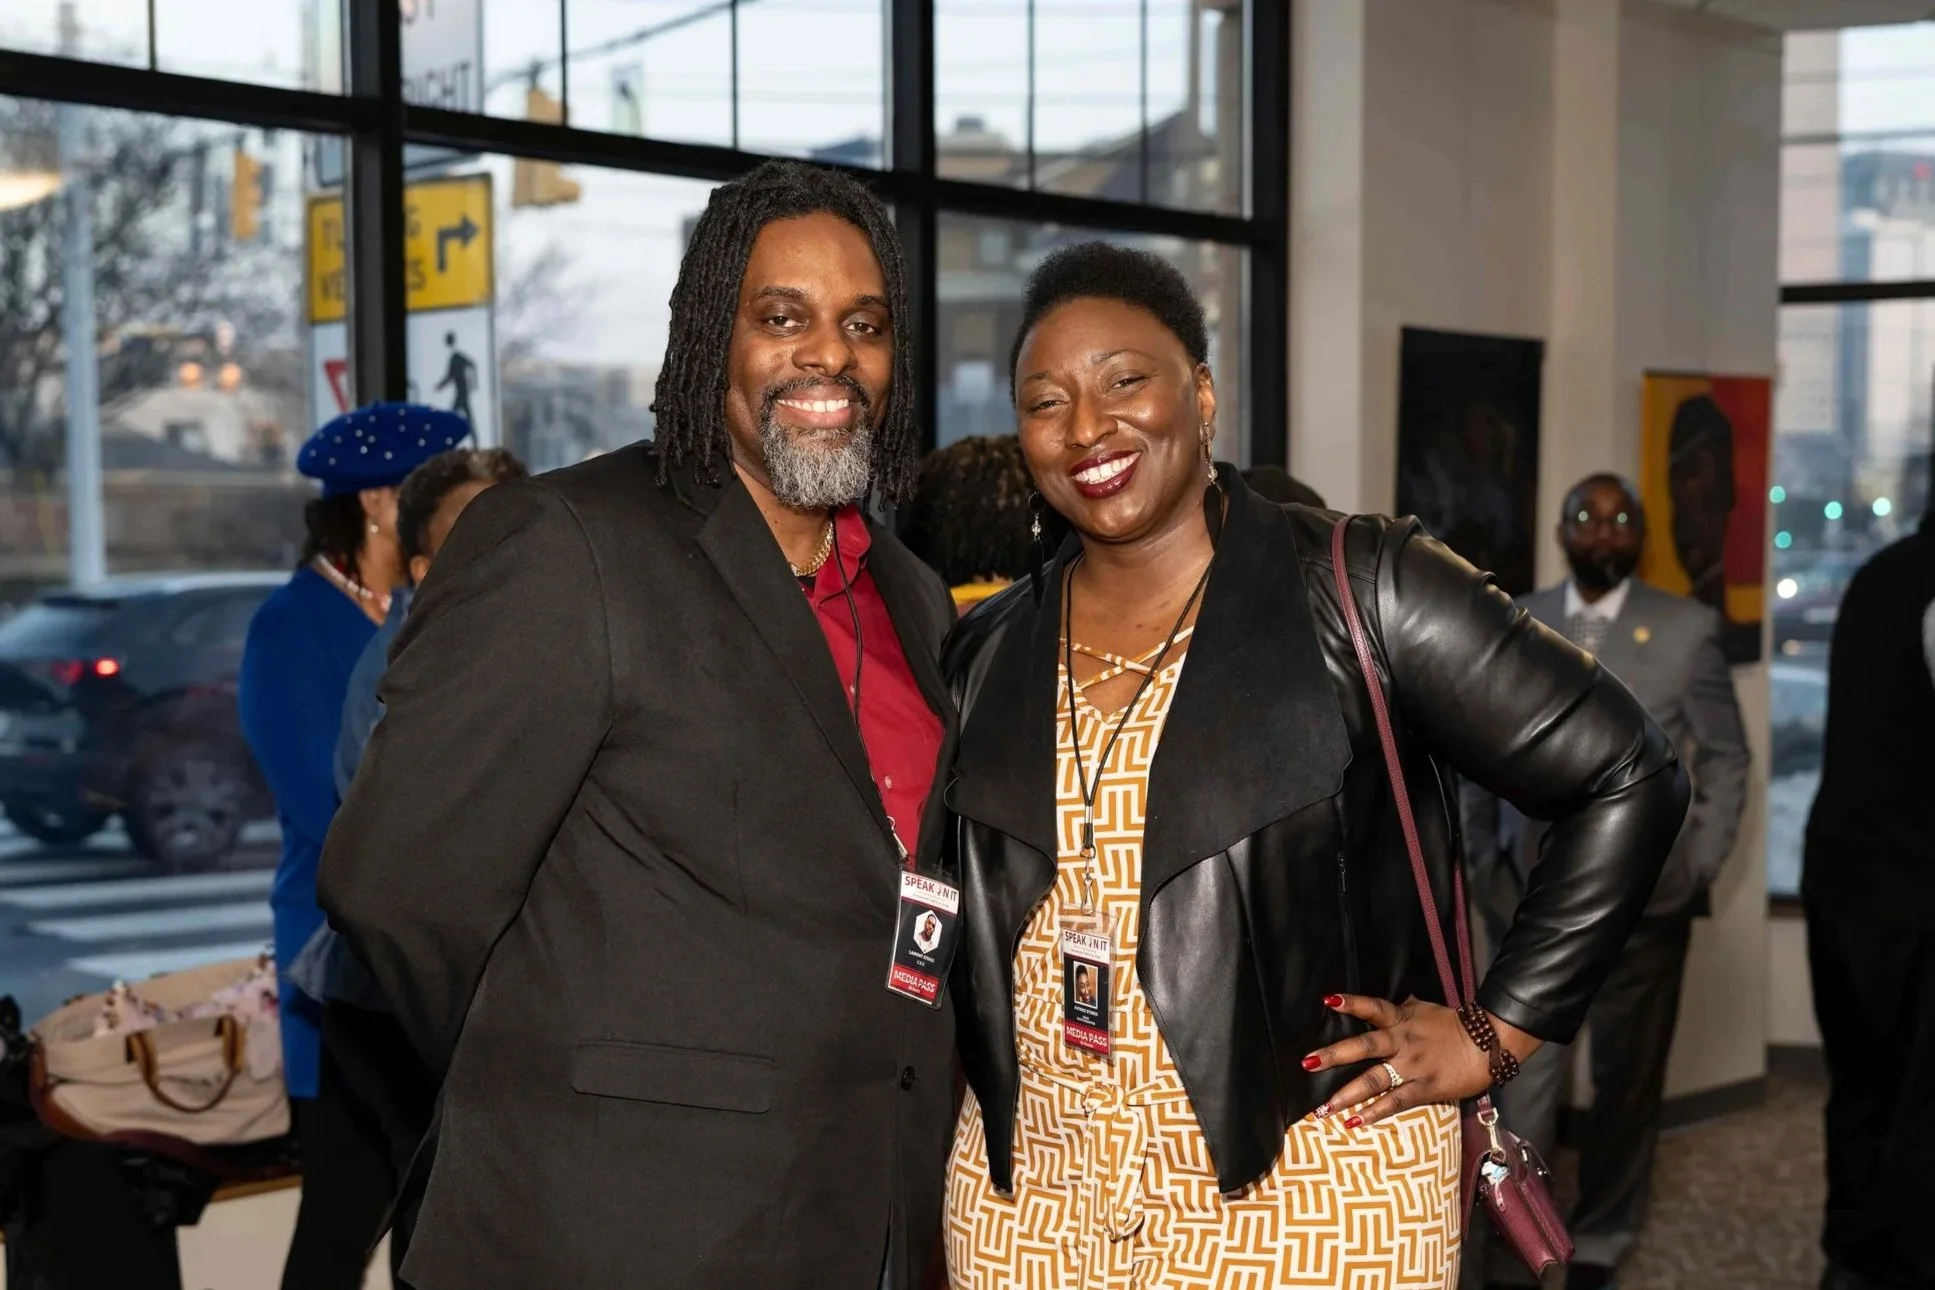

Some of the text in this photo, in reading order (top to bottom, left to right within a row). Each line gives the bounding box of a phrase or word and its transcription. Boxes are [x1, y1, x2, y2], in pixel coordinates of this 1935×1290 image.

[905, 876, 934, 893] SPEAK
[950, 890, 958, 902] IT
[1065, 931, 1087, 946] SPEAK
[1100, 940, 1108, 951] IT
[894, 970, 918, 987] MEDIA
[918, 977, 936, 993] PASS
[1066, 1025, 1088, 1042] MEDIA
[1089, 1033, 1108, 1047] PASS
